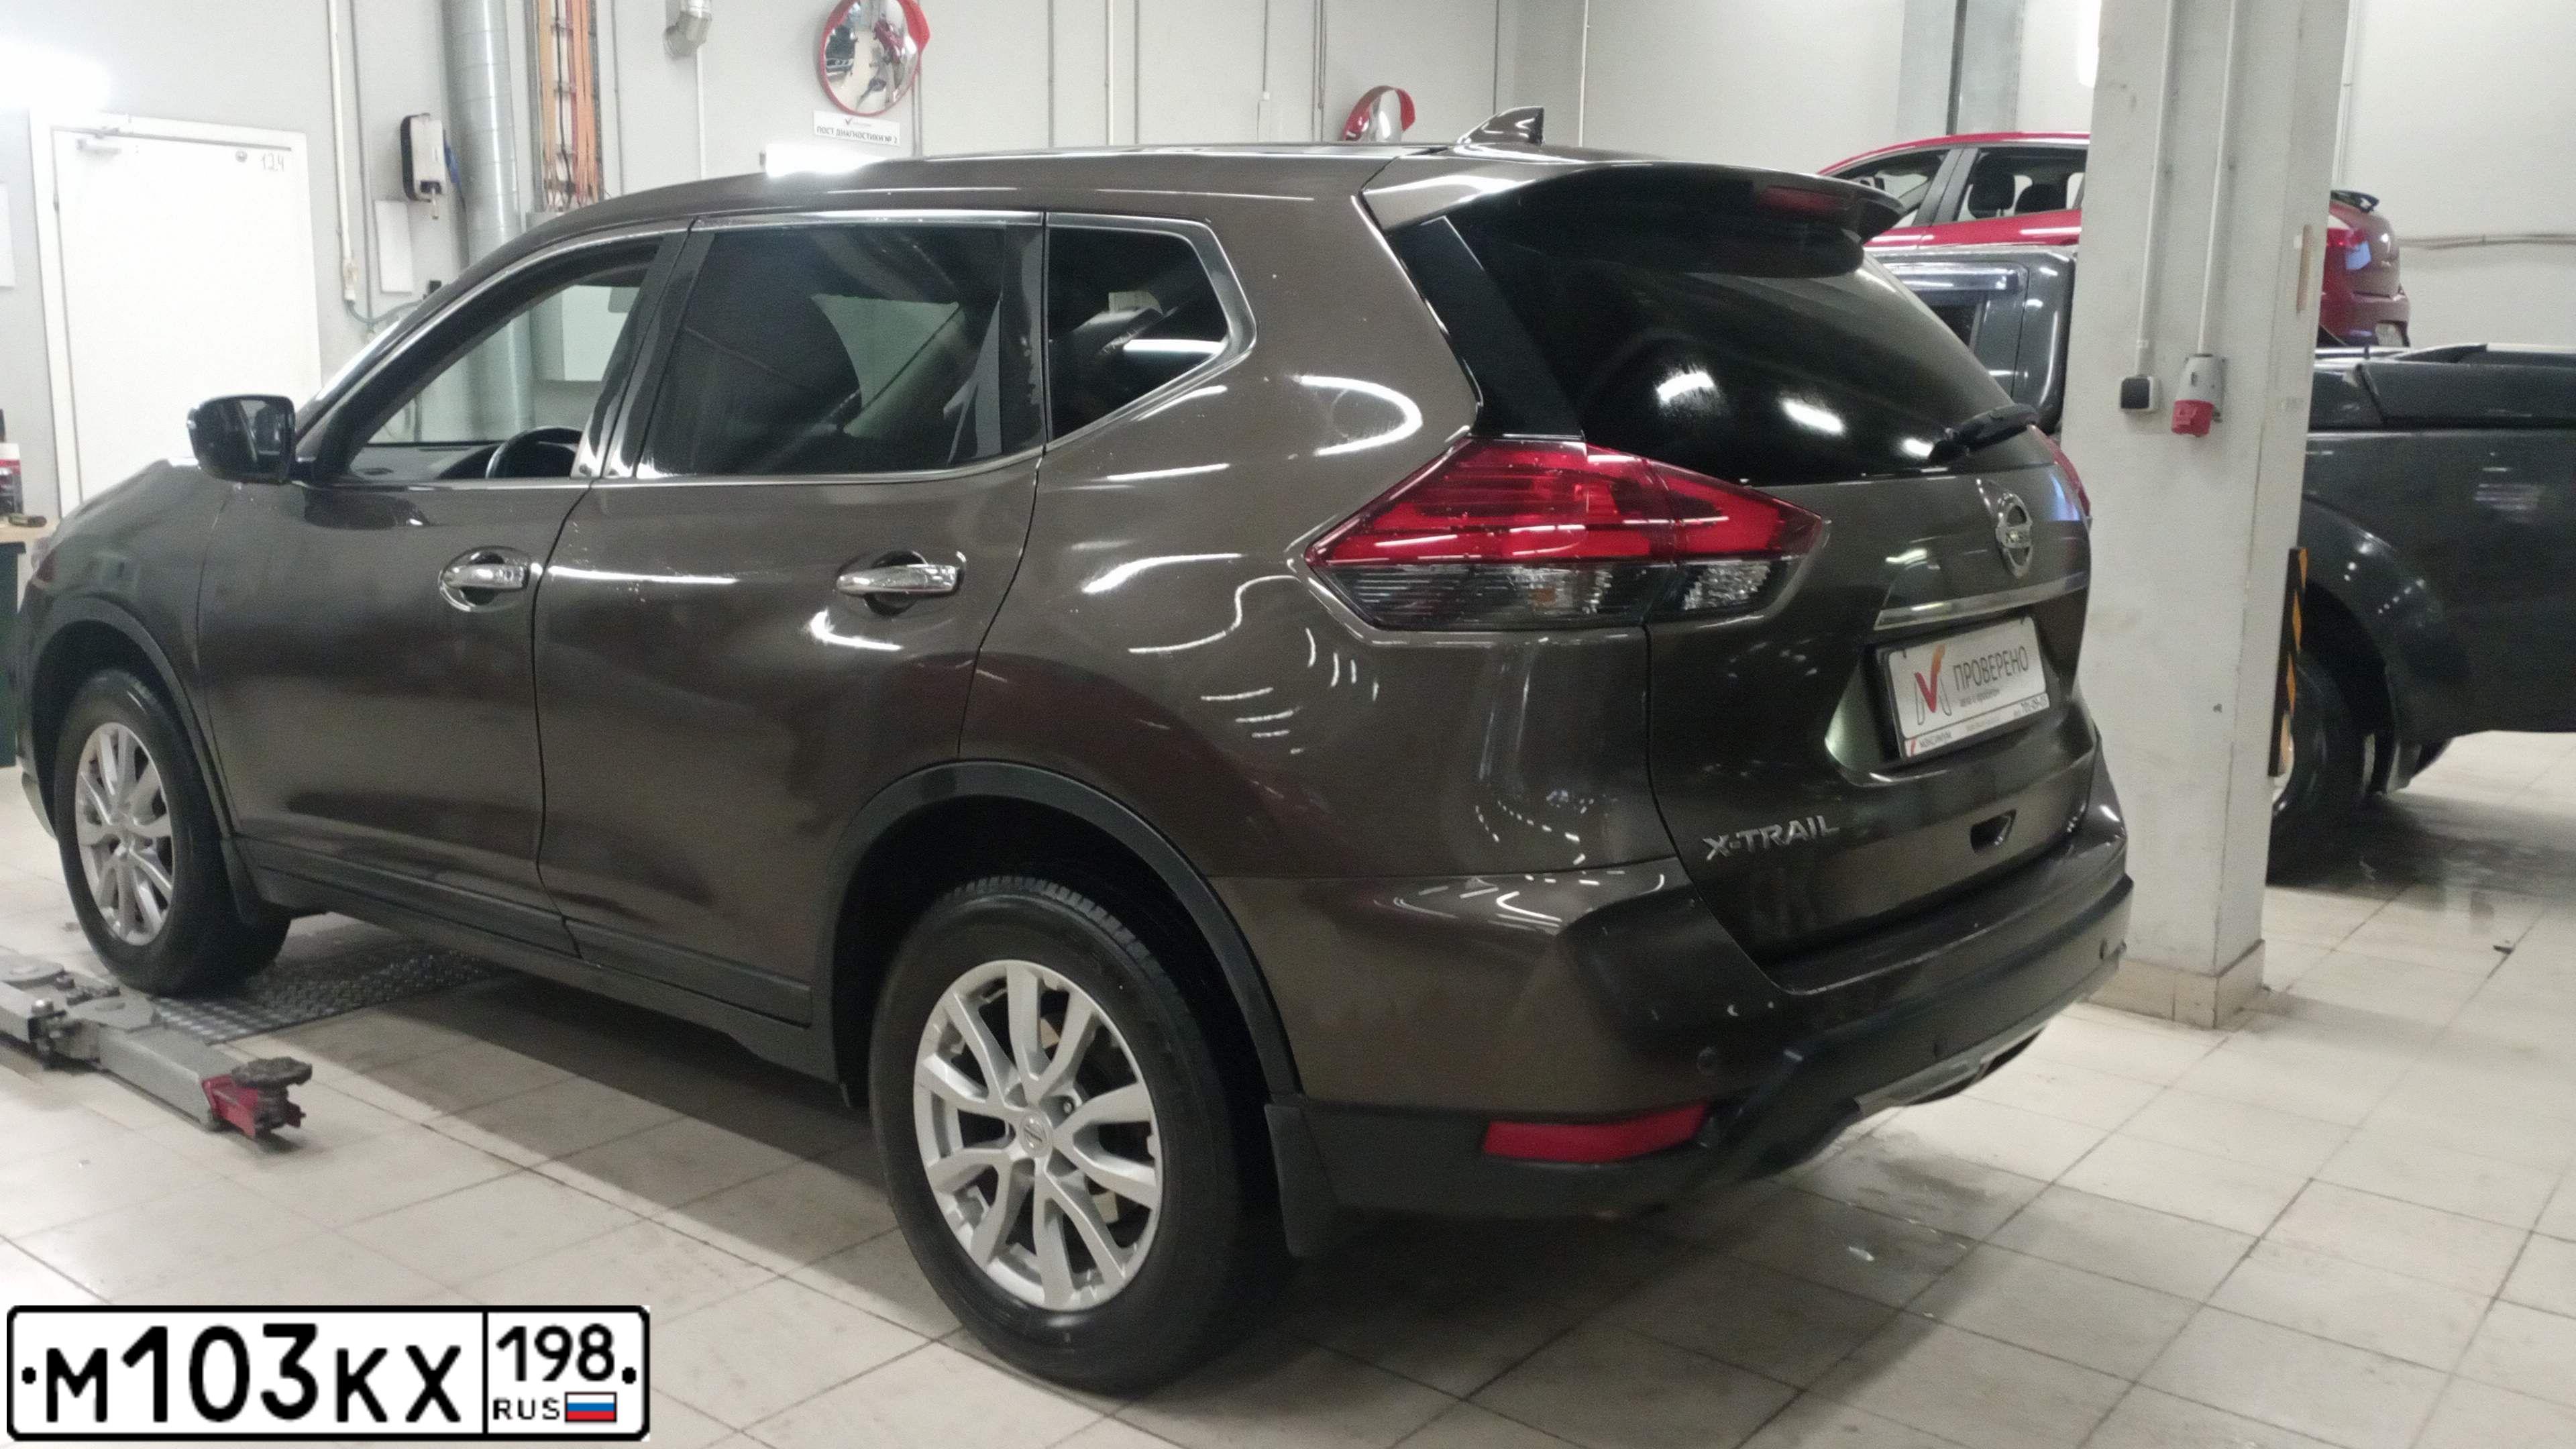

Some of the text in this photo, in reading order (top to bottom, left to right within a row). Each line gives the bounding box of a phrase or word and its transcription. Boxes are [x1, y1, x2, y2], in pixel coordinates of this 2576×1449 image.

[816, 125, 834, 135] ПОСТ
[836, 128, 883, 142] ДИАГНОСТИКИ
[1953, 645, 2029, 692] ПРОВЕРЕНО
[1703, 815, 1839, 861] X-TRAIL
